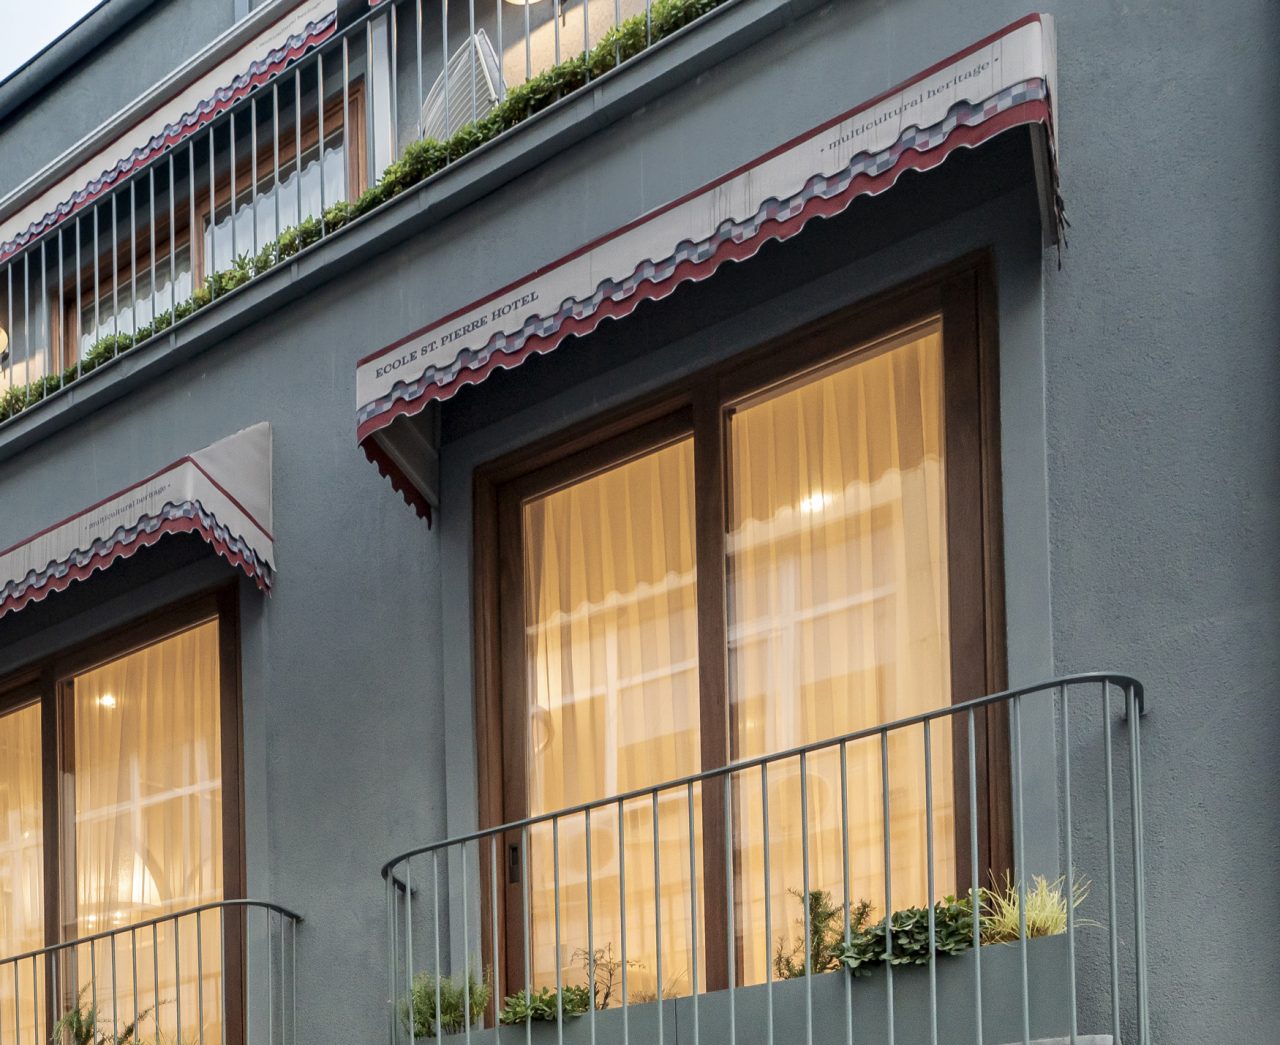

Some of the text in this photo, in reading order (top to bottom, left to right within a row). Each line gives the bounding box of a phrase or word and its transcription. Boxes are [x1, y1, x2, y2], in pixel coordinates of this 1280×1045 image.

[828, 60, 990, 151] multicultural heritage
[375, 290, 539, 379] ECOLE ST. PIERRE HOTEL
